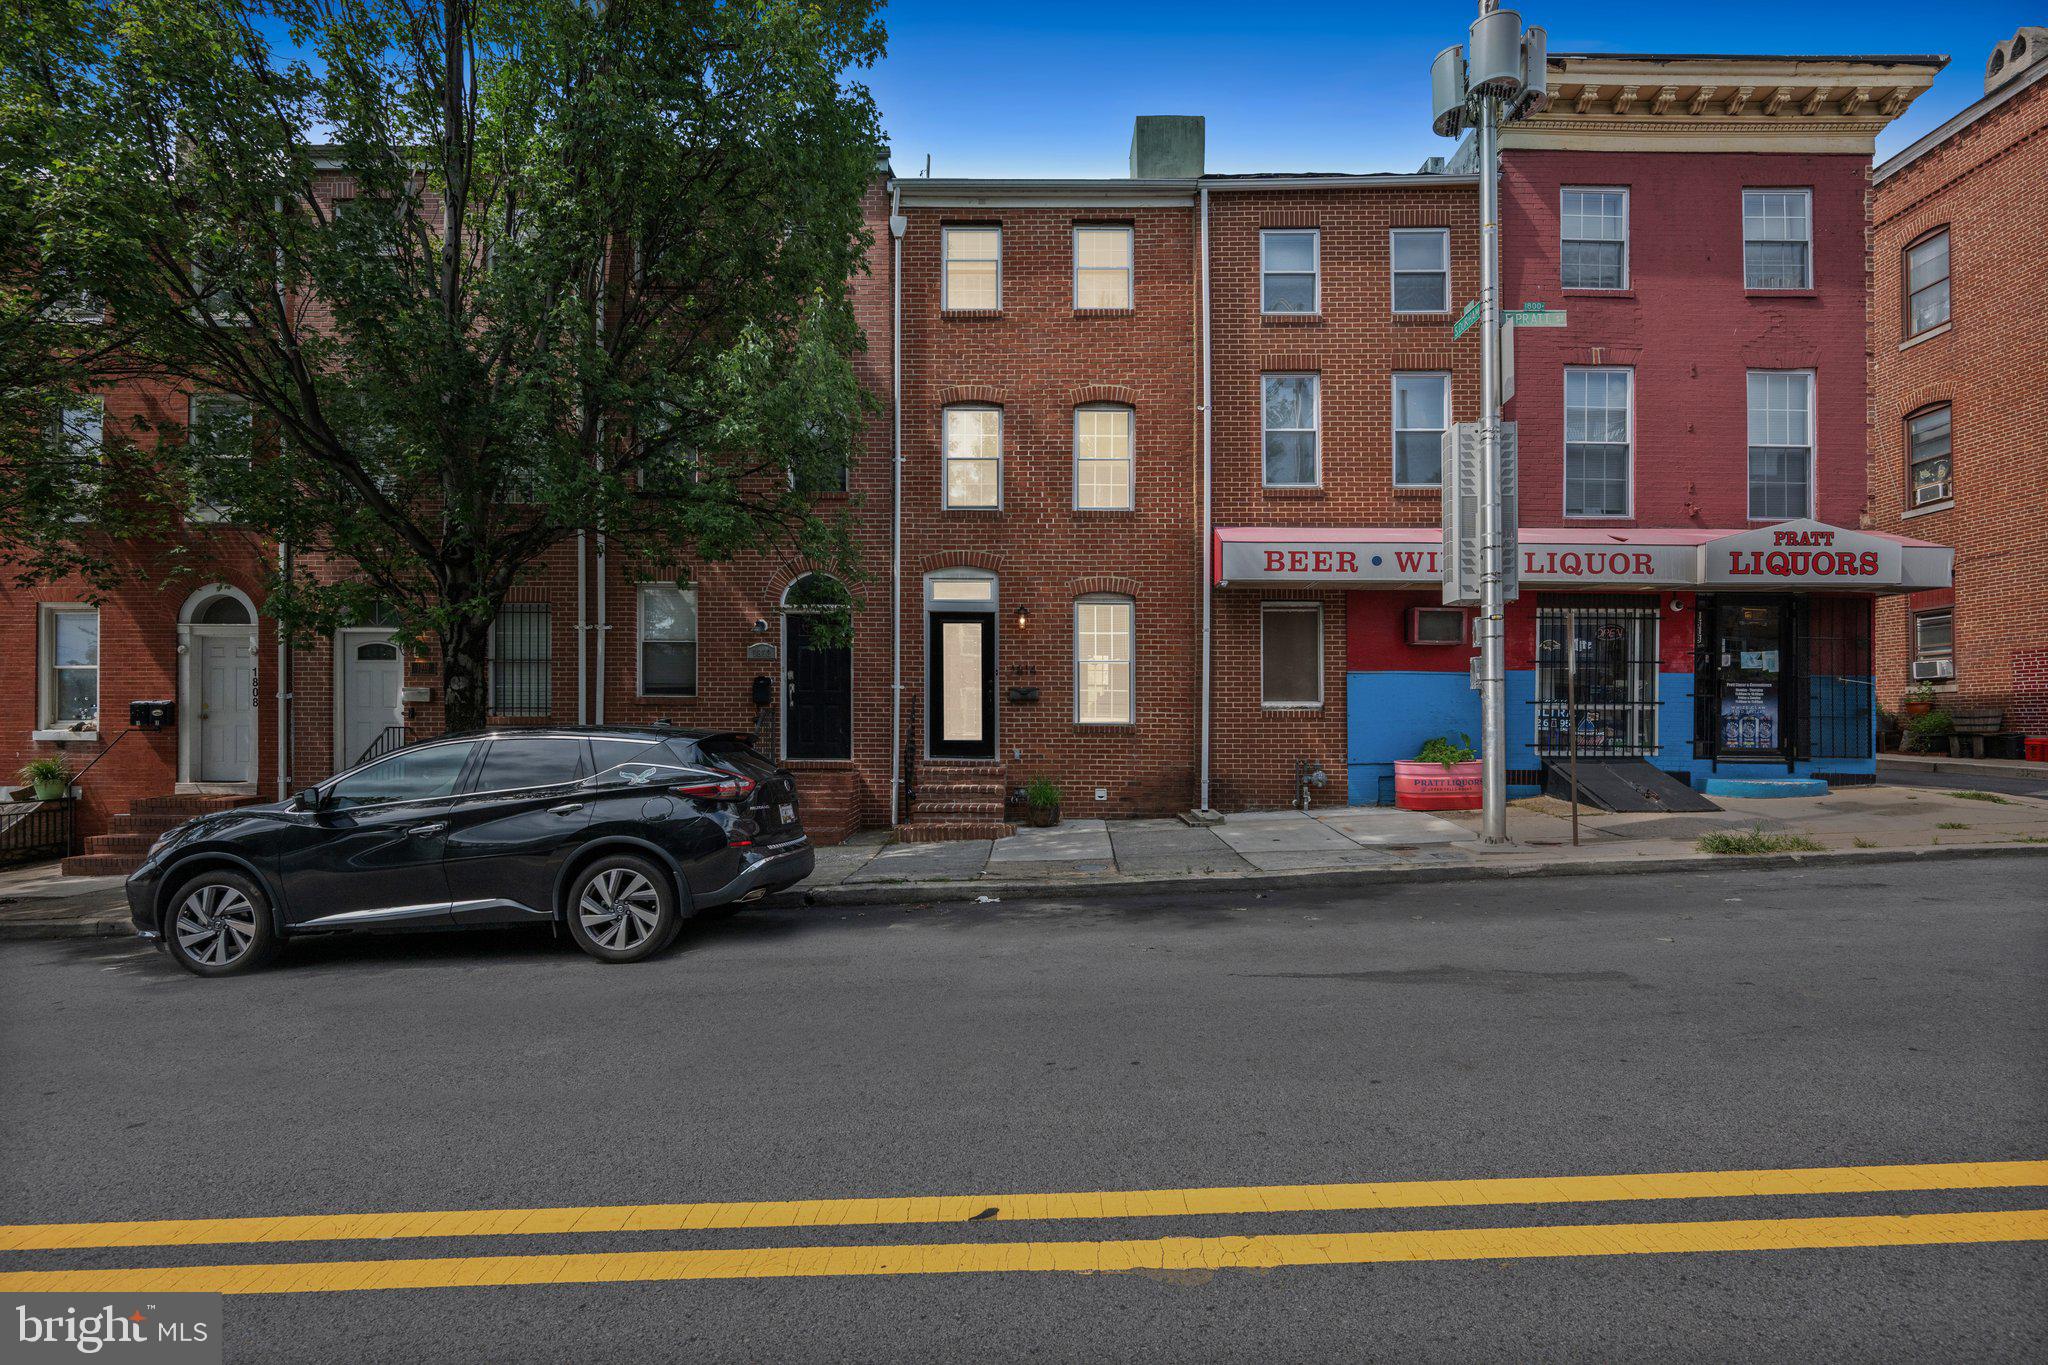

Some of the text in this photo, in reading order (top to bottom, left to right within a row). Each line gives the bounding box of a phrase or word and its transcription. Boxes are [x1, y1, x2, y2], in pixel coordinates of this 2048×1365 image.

[1516, 314, 1552, 325] PRATT
[1774, 531, 1834, 547] PRATT
[1264, 551, 1655, 576] BEER WI LIQUOR
[1729, 551, 1879, 577] LIQUORS
